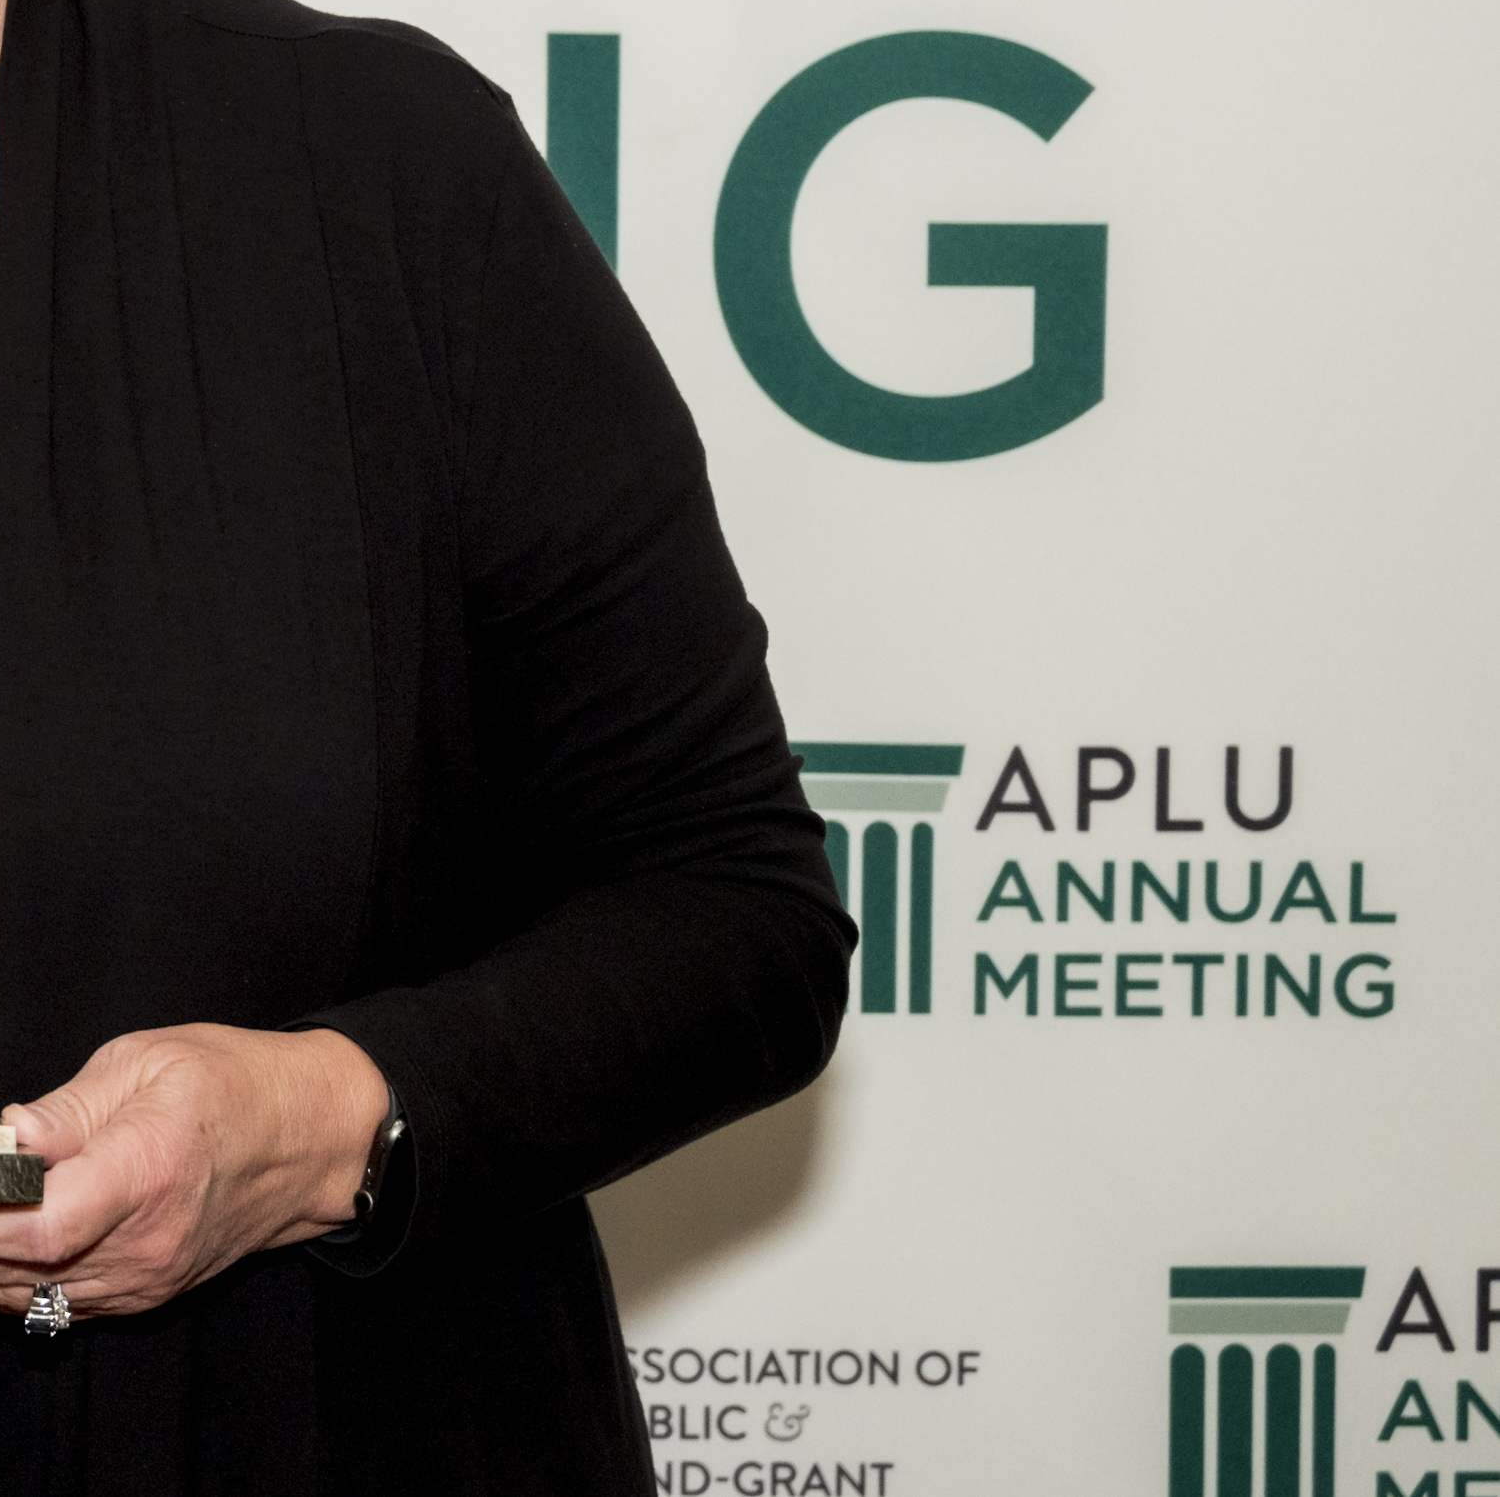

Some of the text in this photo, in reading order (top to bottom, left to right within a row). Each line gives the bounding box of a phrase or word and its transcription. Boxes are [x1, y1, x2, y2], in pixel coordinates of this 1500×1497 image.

[975, 744, 1294, 833] APLU
[976, 859, 1397, 924] ANNUAL
[974, 951, 1395, 1018] MEETING
[915, 1349, 981, 1387] OF
[764, 1402, 811, 1442] &
